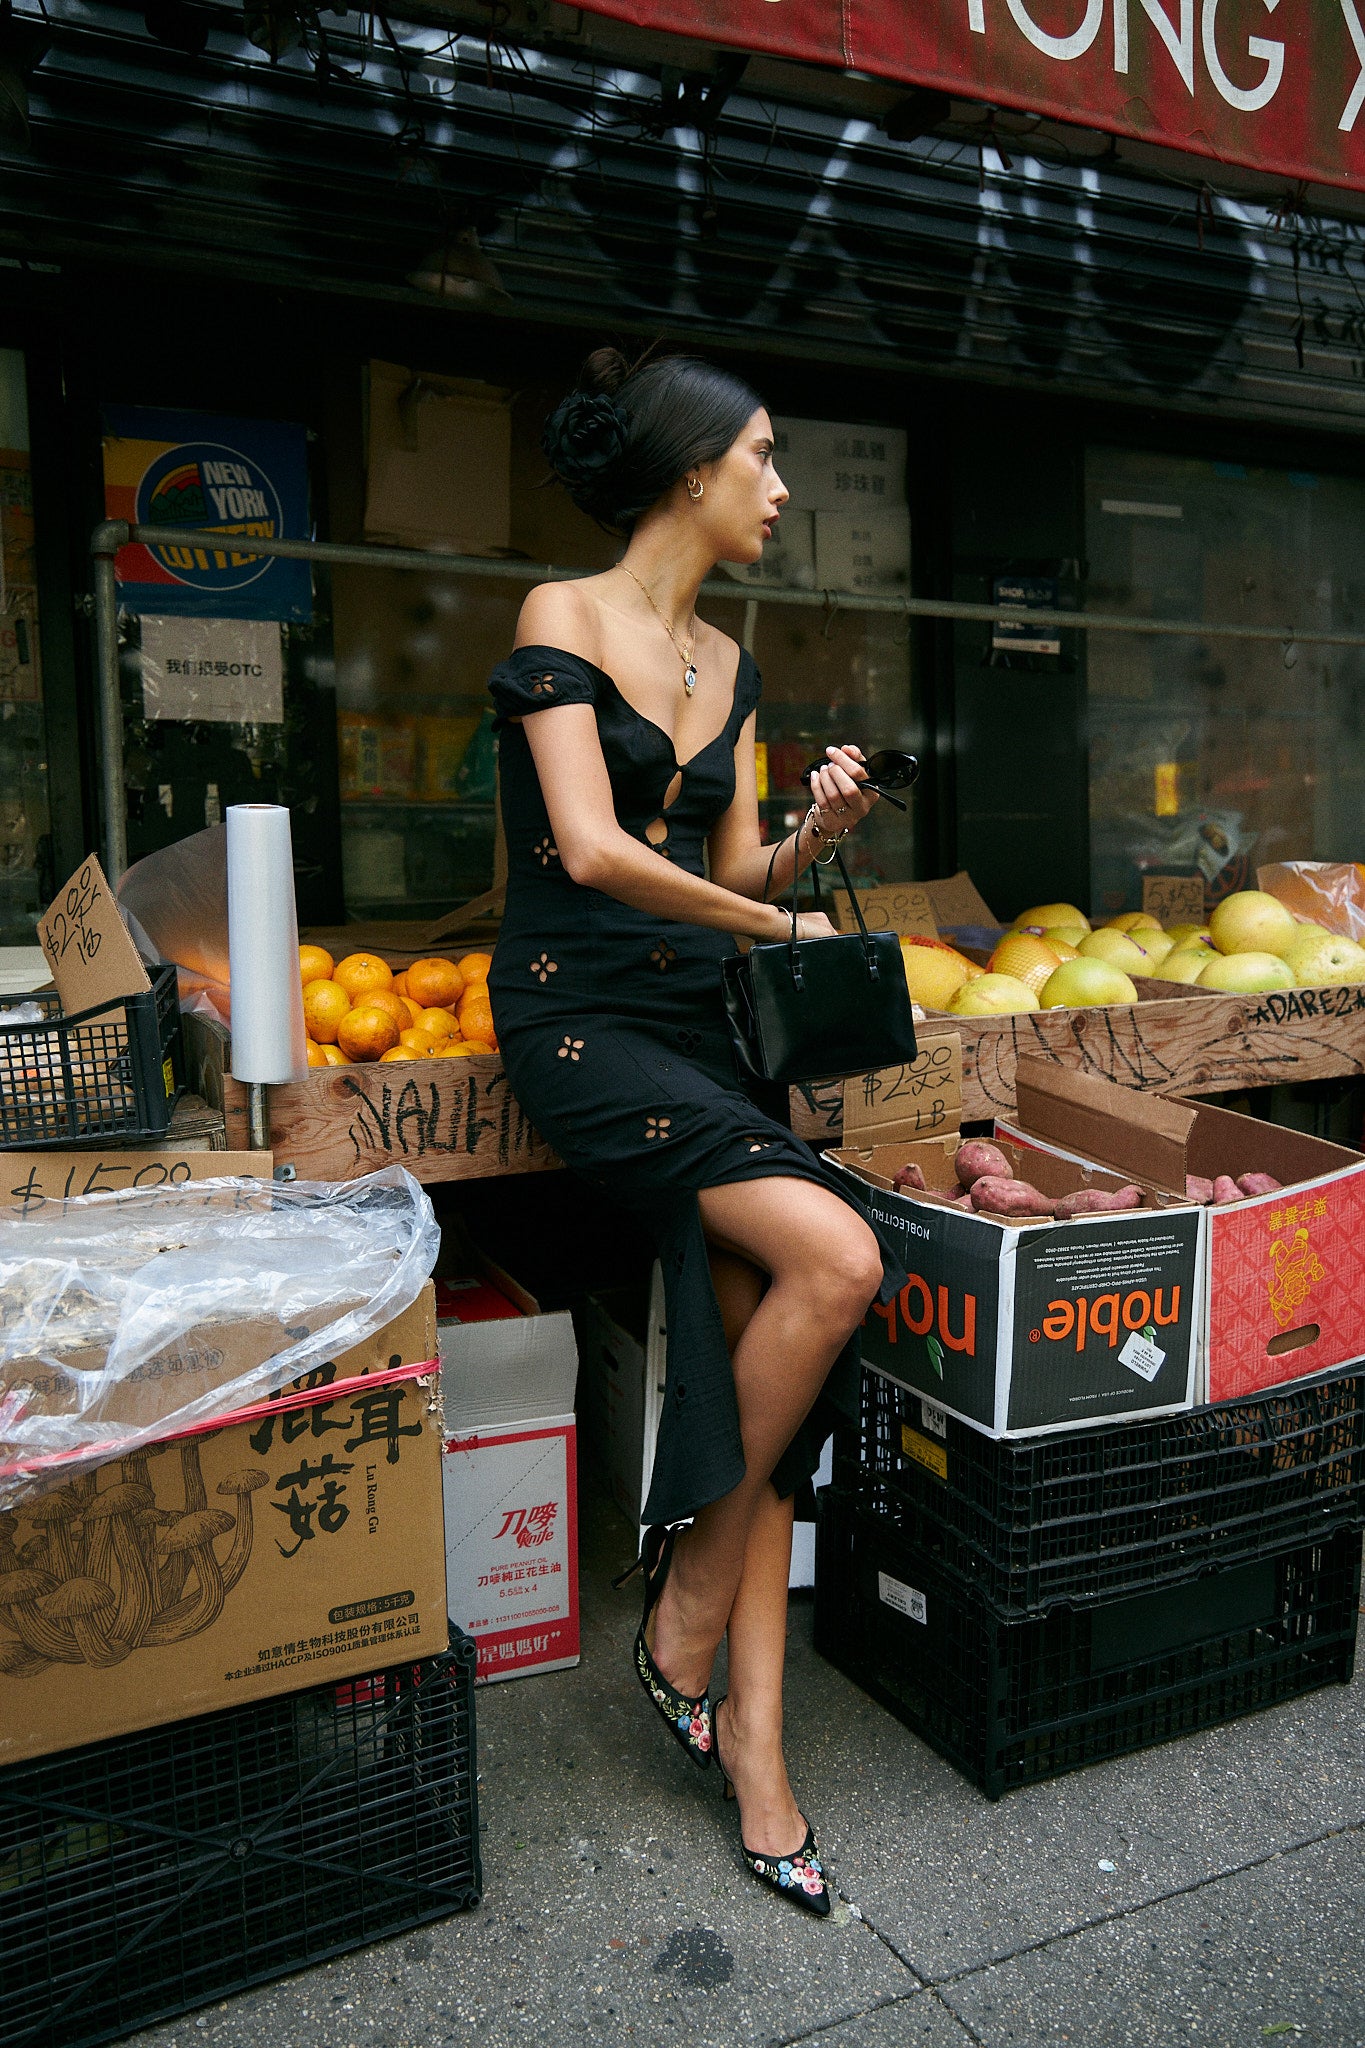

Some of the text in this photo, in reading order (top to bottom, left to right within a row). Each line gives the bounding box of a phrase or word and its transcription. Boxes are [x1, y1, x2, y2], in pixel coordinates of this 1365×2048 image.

[202, 461, 252, 487] NEW
[209, 486, 269, 521] YORK
[165, 658, 263, 677] 我们接受OTC
[1042, 1284, 1181, 1353] noble
[270, 1453, 354, 1558] 菇
[366, 1464, 379, 1534] Lu Rong Gu
[491, 1501, 559, 1540] 刀嘜
[516, 1526, 554, 1549] Knife
[477, 1562, 561, 1587] 刀嘜純正花生油
[490, 1564, 509, 1572] PURE
[510, 1559, 537, 1568] PEANUT
[532, 1584, 538, 1592] 4
[257, 1613, 420, 1662] 如意情生物科技股份有限公司
